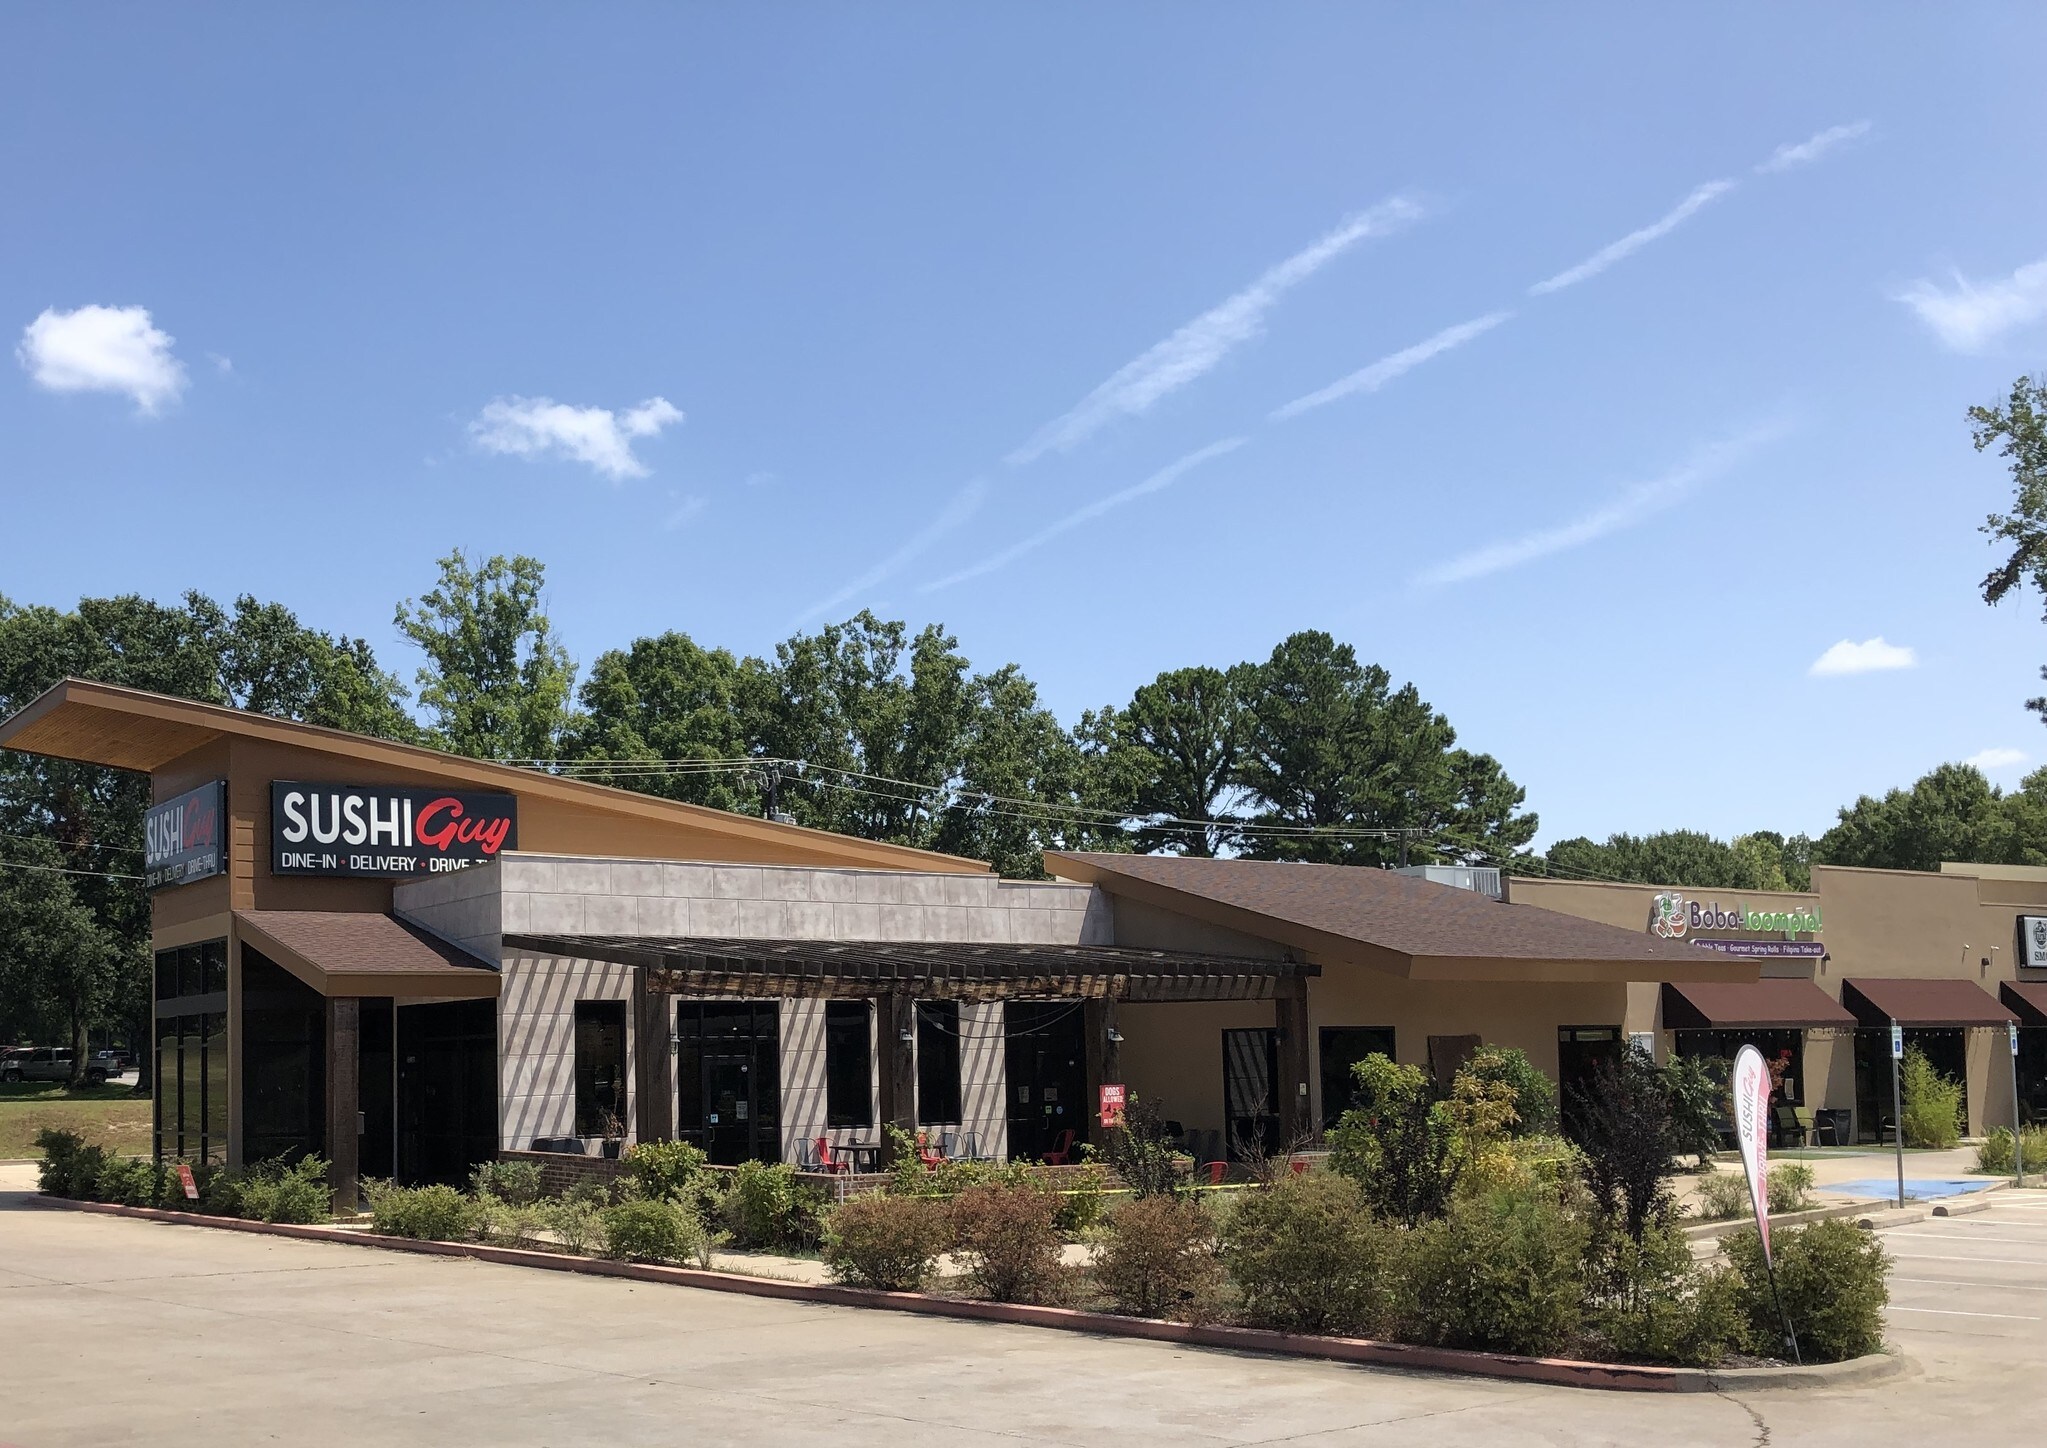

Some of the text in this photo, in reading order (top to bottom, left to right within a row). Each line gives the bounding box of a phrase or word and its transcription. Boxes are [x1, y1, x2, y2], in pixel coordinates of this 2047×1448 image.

[146, 796, 215, 864] SUSHI Guy
[282, 792, 510, 854] SUSHI Guy
[282, 853, 337, 869] DINE-IN
[350, 856, 417, 872] DELIVERY
[1730, 944, 1750, 952] Gourmet
[1751, 945, 1767, 954] Spring
[1768, 945, 1779, 953] Rolls
[2034, 951, 2047, 961] SM
[1105, 1087, 1120, 1096] DOGS
[1742, 1093, 1753, 1142] SUSHI
